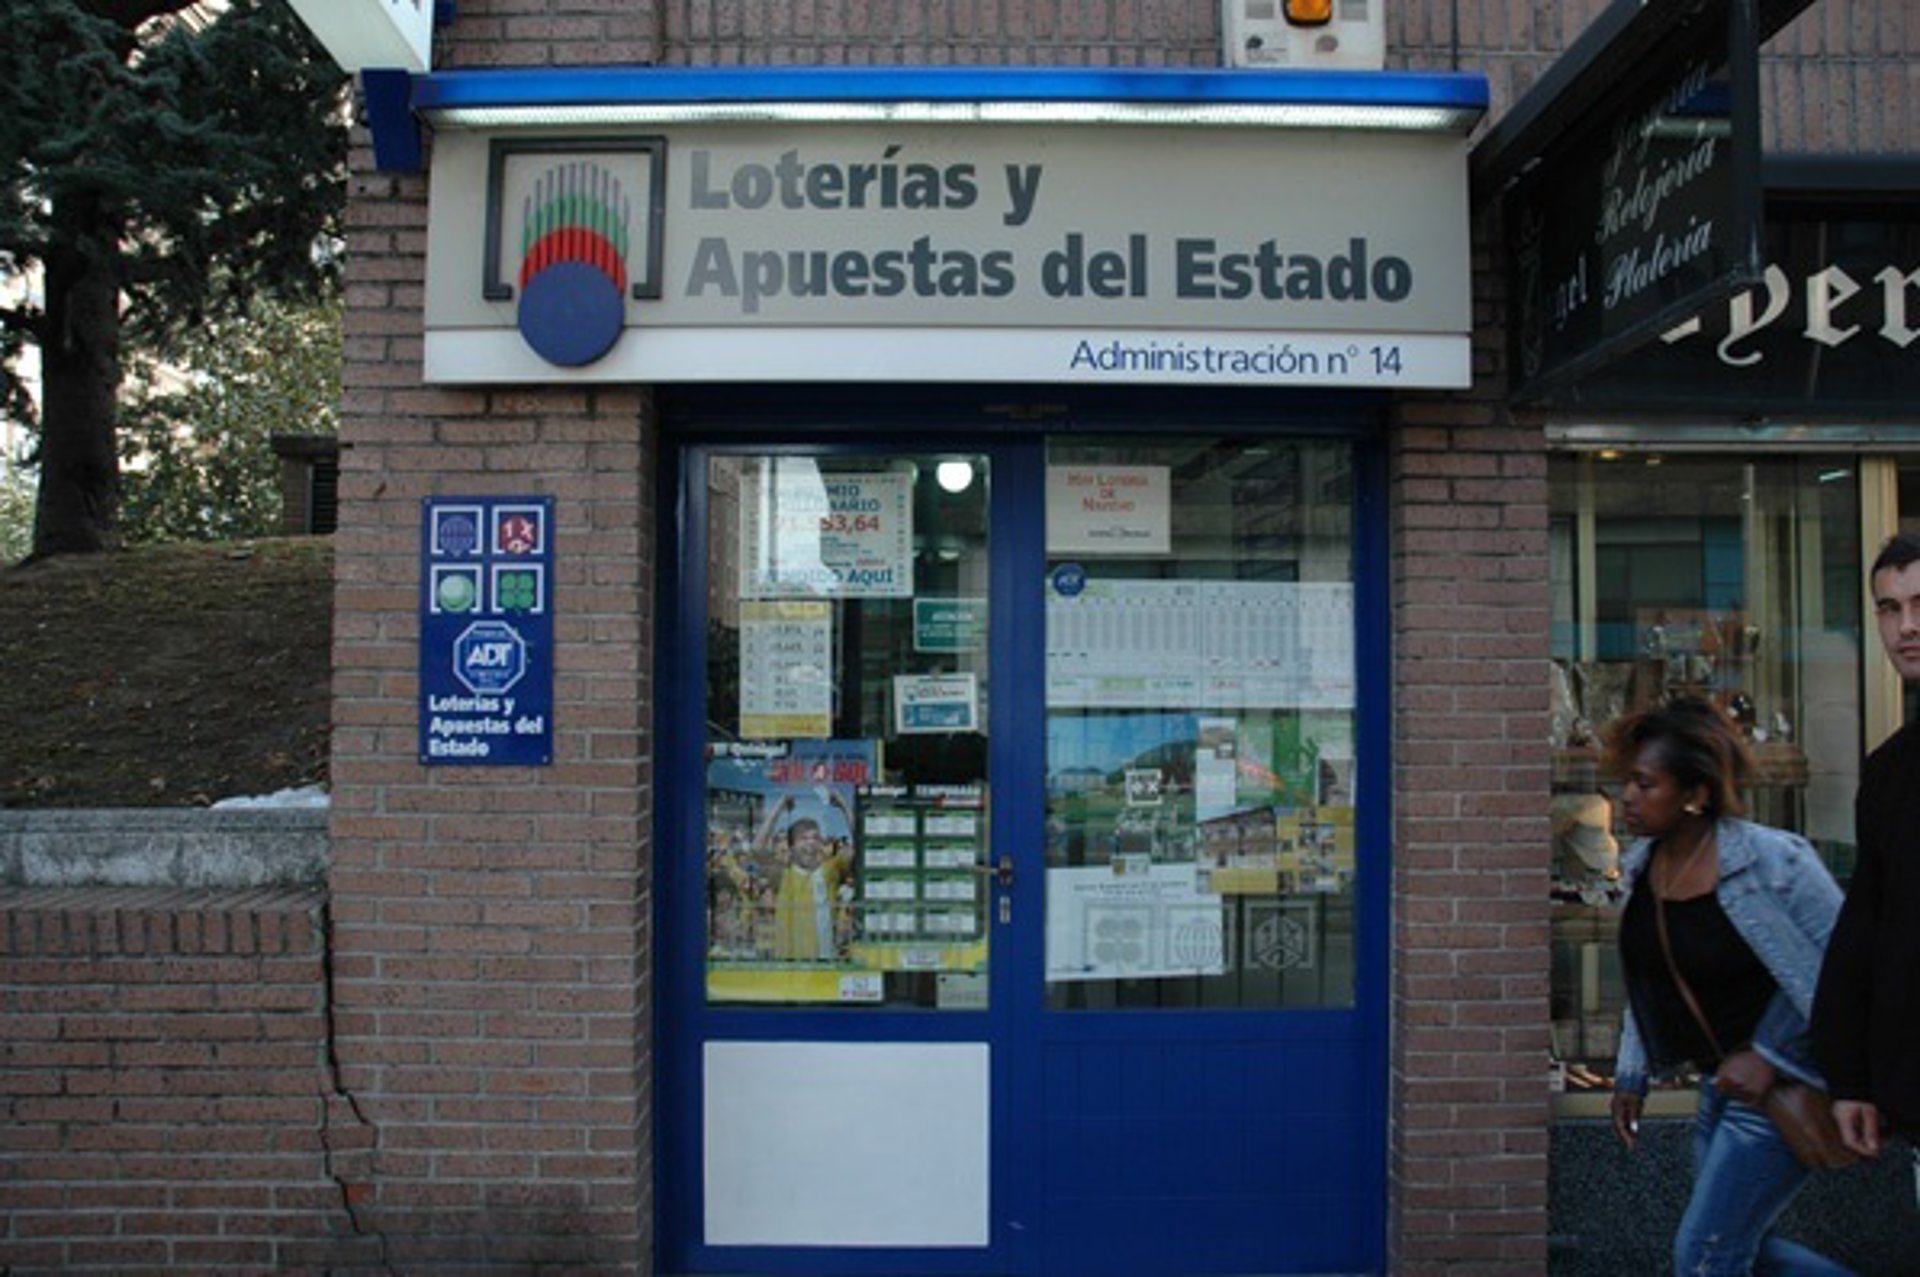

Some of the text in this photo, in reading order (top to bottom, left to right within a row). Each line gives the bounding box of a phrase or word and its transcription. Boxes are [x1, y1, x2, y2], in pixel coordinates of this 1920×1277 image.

[689, 144, 1043, 226] Loterías y
[685, 232, 1414, 314] Apuestas del Estado
[1070, 339, 1319, 376] Administración
[1369, 345, 1403, 376] 14
[466, 642, 513, 668] ADT
[429, 716, 544, 738] Apuestas del
[428, 739, 491, 757] Estado
